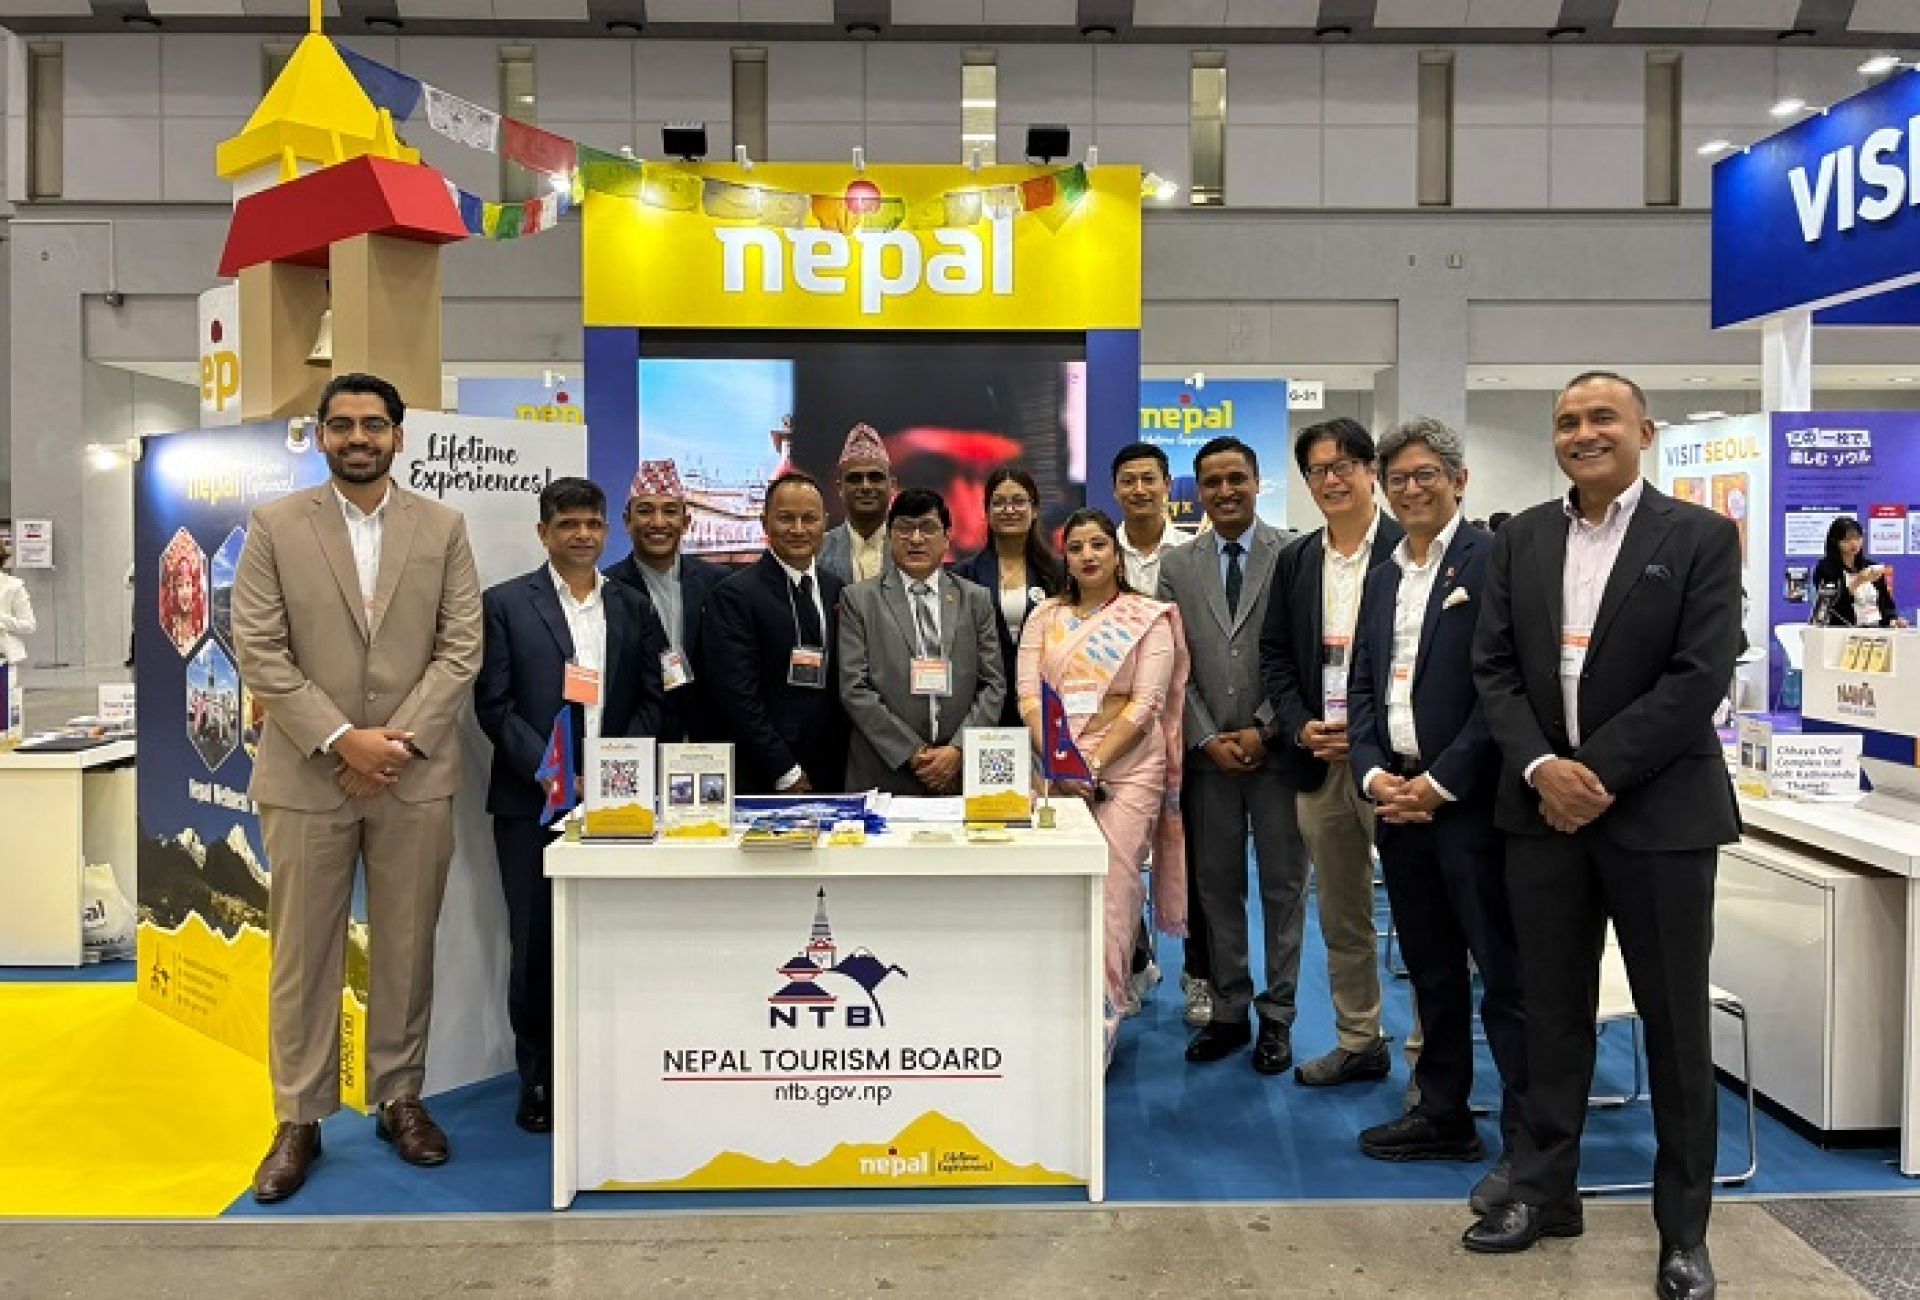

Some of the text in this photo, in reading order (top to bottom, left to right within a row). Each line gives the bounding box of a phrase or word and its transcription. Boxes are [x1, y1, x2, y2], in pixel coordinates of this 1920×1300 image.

[1788, 114, 1920, 242] VISI
[714, 210, 1014, 313] nepal
[1141, 400, 1233, 434] nepal
[427, 433, 519, 472] Lifetime
[1664, 435, 1762, 467] VISIT SEOUL
[409, 459, 553, 499] Experiences!
[1776, 758, 1821, 768] Complex
[1819, 746, 1843, 755] Devi
[770, 1006, 871, 1028] NTB
[663, 1047, 1003, 1073] NEPAL TOURISM BOARD
[775, 1083, 893, 1106] ntb.gov.np
[859, 1151, 928, 1178] nepal
